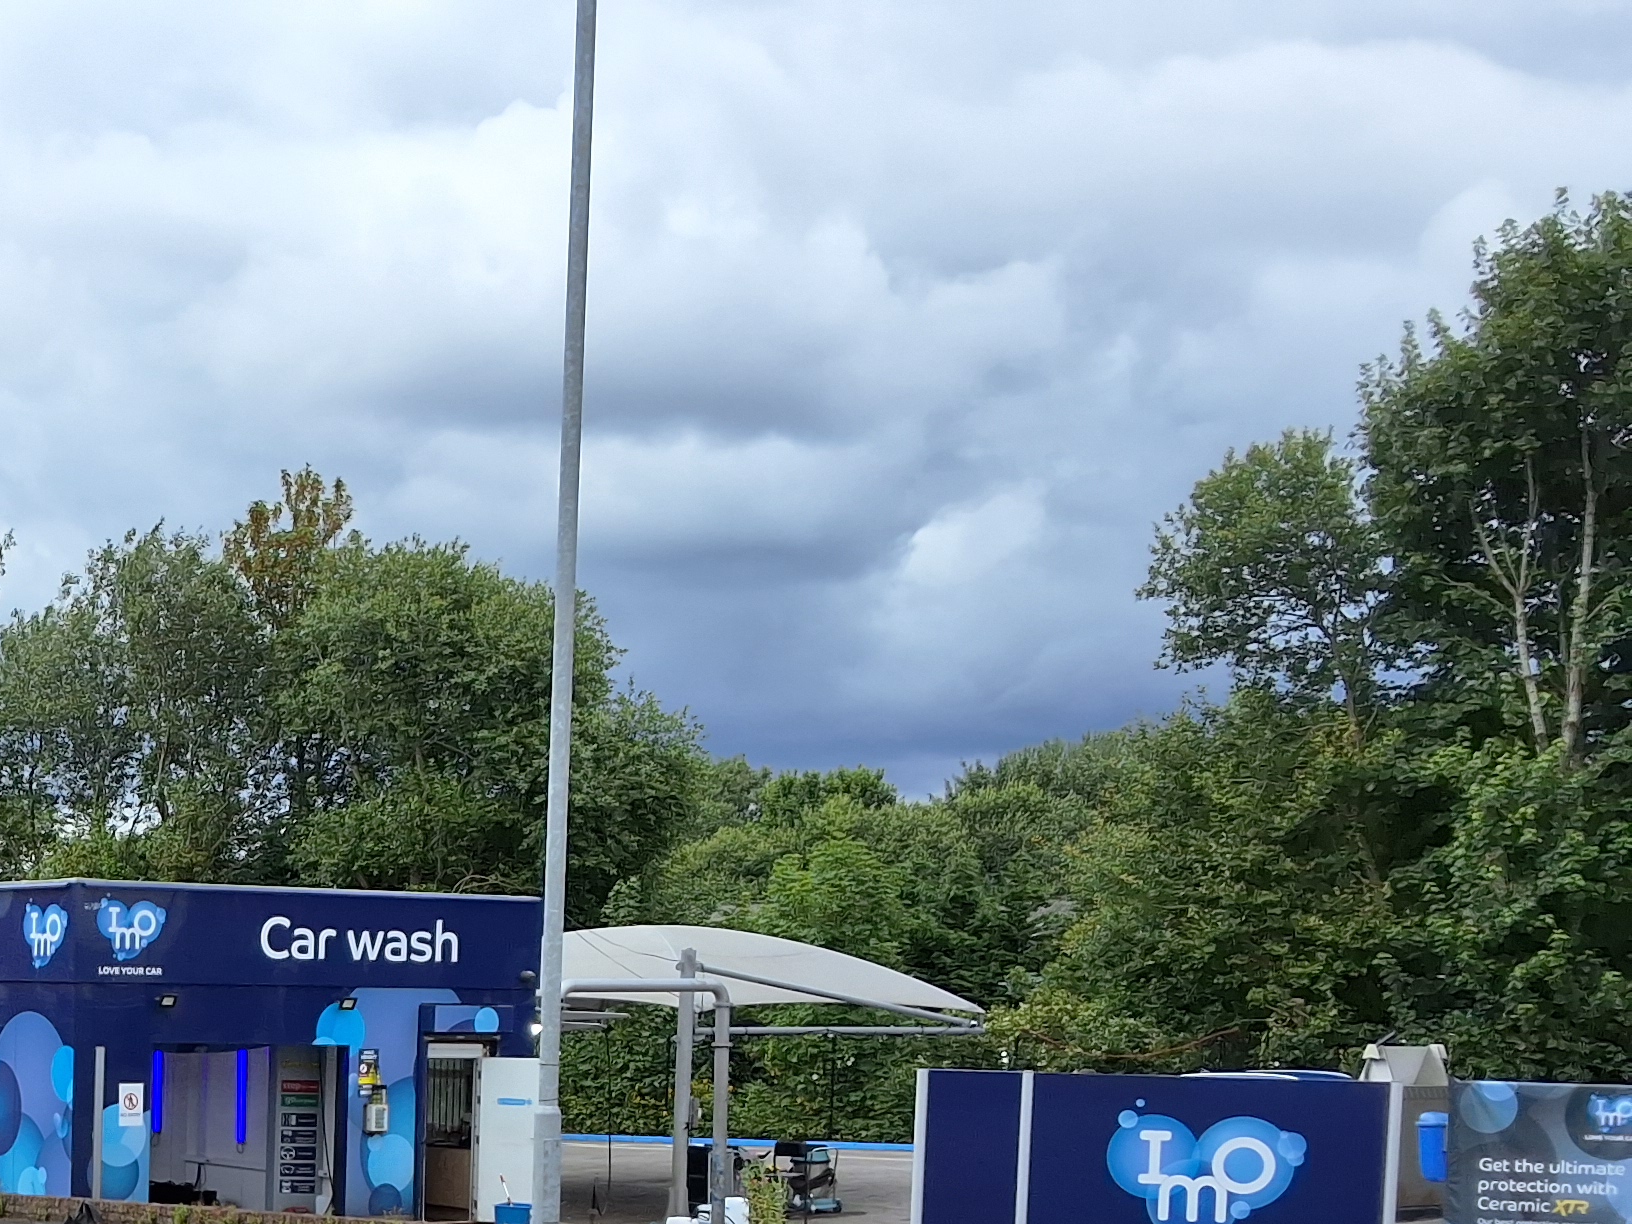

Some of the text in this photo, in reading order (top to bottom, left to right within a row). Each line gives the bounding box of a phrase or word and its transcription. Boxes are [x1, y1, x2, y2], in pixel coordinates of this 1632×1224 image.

[260, 916, 459, 963] Car wash
[98, 965, 163, 976] LOVE YOUR CAR
[1478, 1157, 1626, 1177] Get the ultimate
[1477, 1178, 1618, 1196] protection with
[1477, 1196, 1590, 1217] Ceramic XTR
